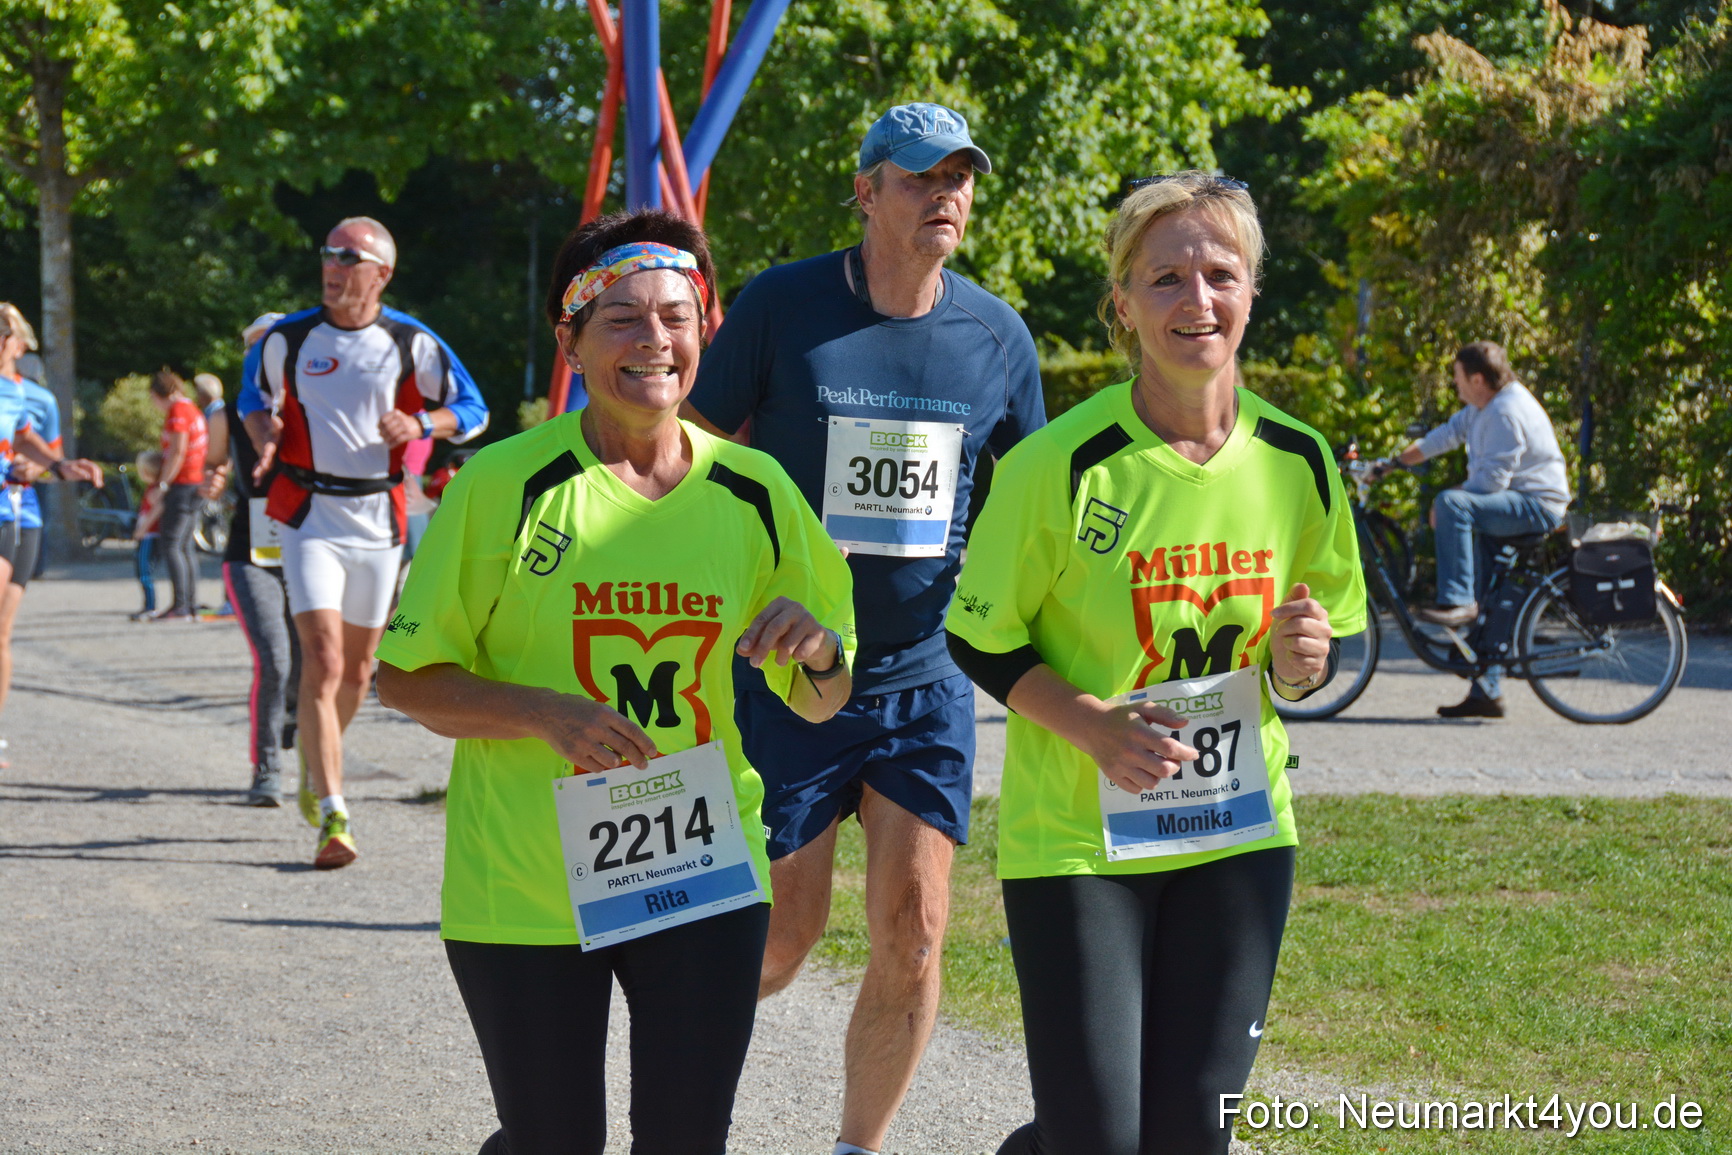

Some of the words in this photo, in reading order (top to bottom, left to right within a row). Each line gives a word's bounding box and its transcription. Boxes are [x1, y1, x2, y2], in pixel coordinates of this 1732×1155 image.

[871, 431, 928, 448] BOCK
[847, 456, 938, 499] 3054
[854, 502, 884, 512] PARTL
[886, 505, 923, 514] Neumarkt
[1126, 541, 1273, 584] Müller
[572, 581, 723, 618] Müller
[1162, 624, 1244, 683] M
[610, 661, 681, 728] M
[1168, 719, 1241, 780] 187
[609, 769, 684, 804] BOCK
[1140, 791, 1178, 802] PARTL
[1181, 784, 1229, 799] Neumarkt
[589, 796, 715, 873] 2214
[1156, 809, 1233, 836] Monika
[608, 873, 644, 889] PARTL
[646, 860, 698, 880] Neumarkt
[644, 888, 690, 914] Rita
